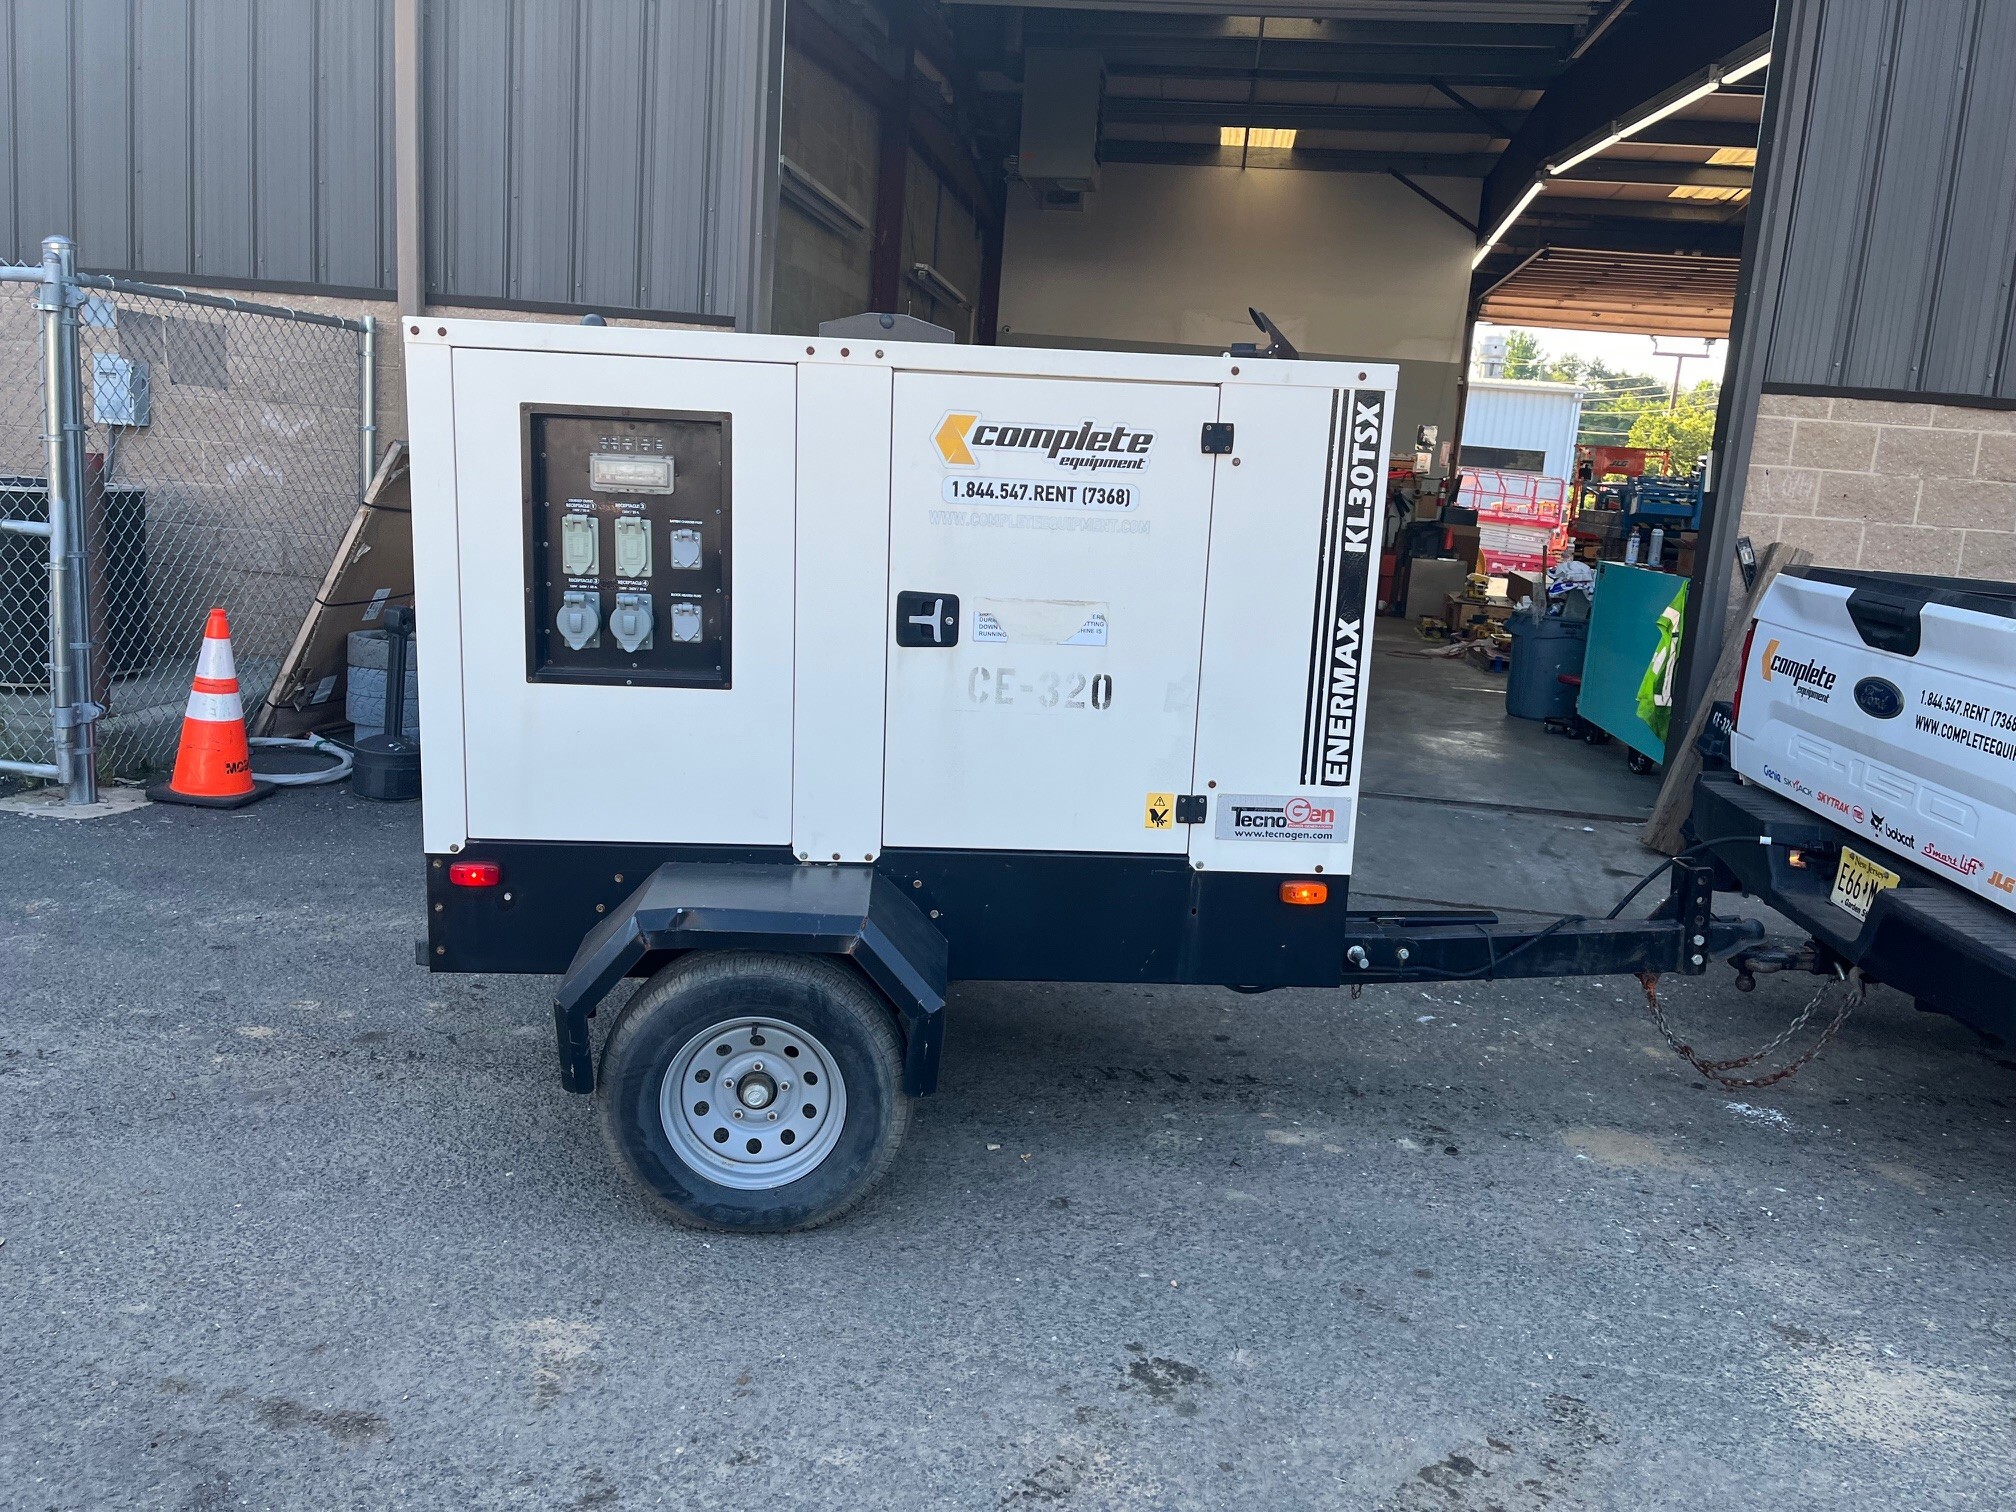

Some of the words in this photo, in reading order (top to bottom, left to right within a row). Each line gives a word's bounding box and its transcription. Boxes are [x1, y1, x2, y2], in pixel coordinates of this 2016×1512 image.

[972, 421, 1154, 459] complete
[1059, 455, 1146, 471] equipment
[952, 481, 1077, 503] 1.844.547.RENT
[1082, 486, 1131, 507] (7368)
[1324, 617, 1361, 783] ENERMAX
[1344, 401, 1381, 553] KL30TSX
[968, 666, 1112, 710] CE-320
[1771, 655, 1836, 690] complete
[1920, 690, 1990, 723] 1.844.547.RENT
[1235, 830, 1333, 840] www.tecnogen.com
[1764, 764, 1781, 782] Genie
[1817, 791, 1850, 814] SKYTRAK
[1885, 823, 1915, 849] bobcat
[1923, 843, 1957, 866] Smart
[1987, 871, 2016, 894] JLG
[1838, 862, 1862, 899] E66
[1855, 856, 1867, 869] New
[1867, 863, 1884, 879] Jersey
[1845, 898, 1861, 914] Garden
